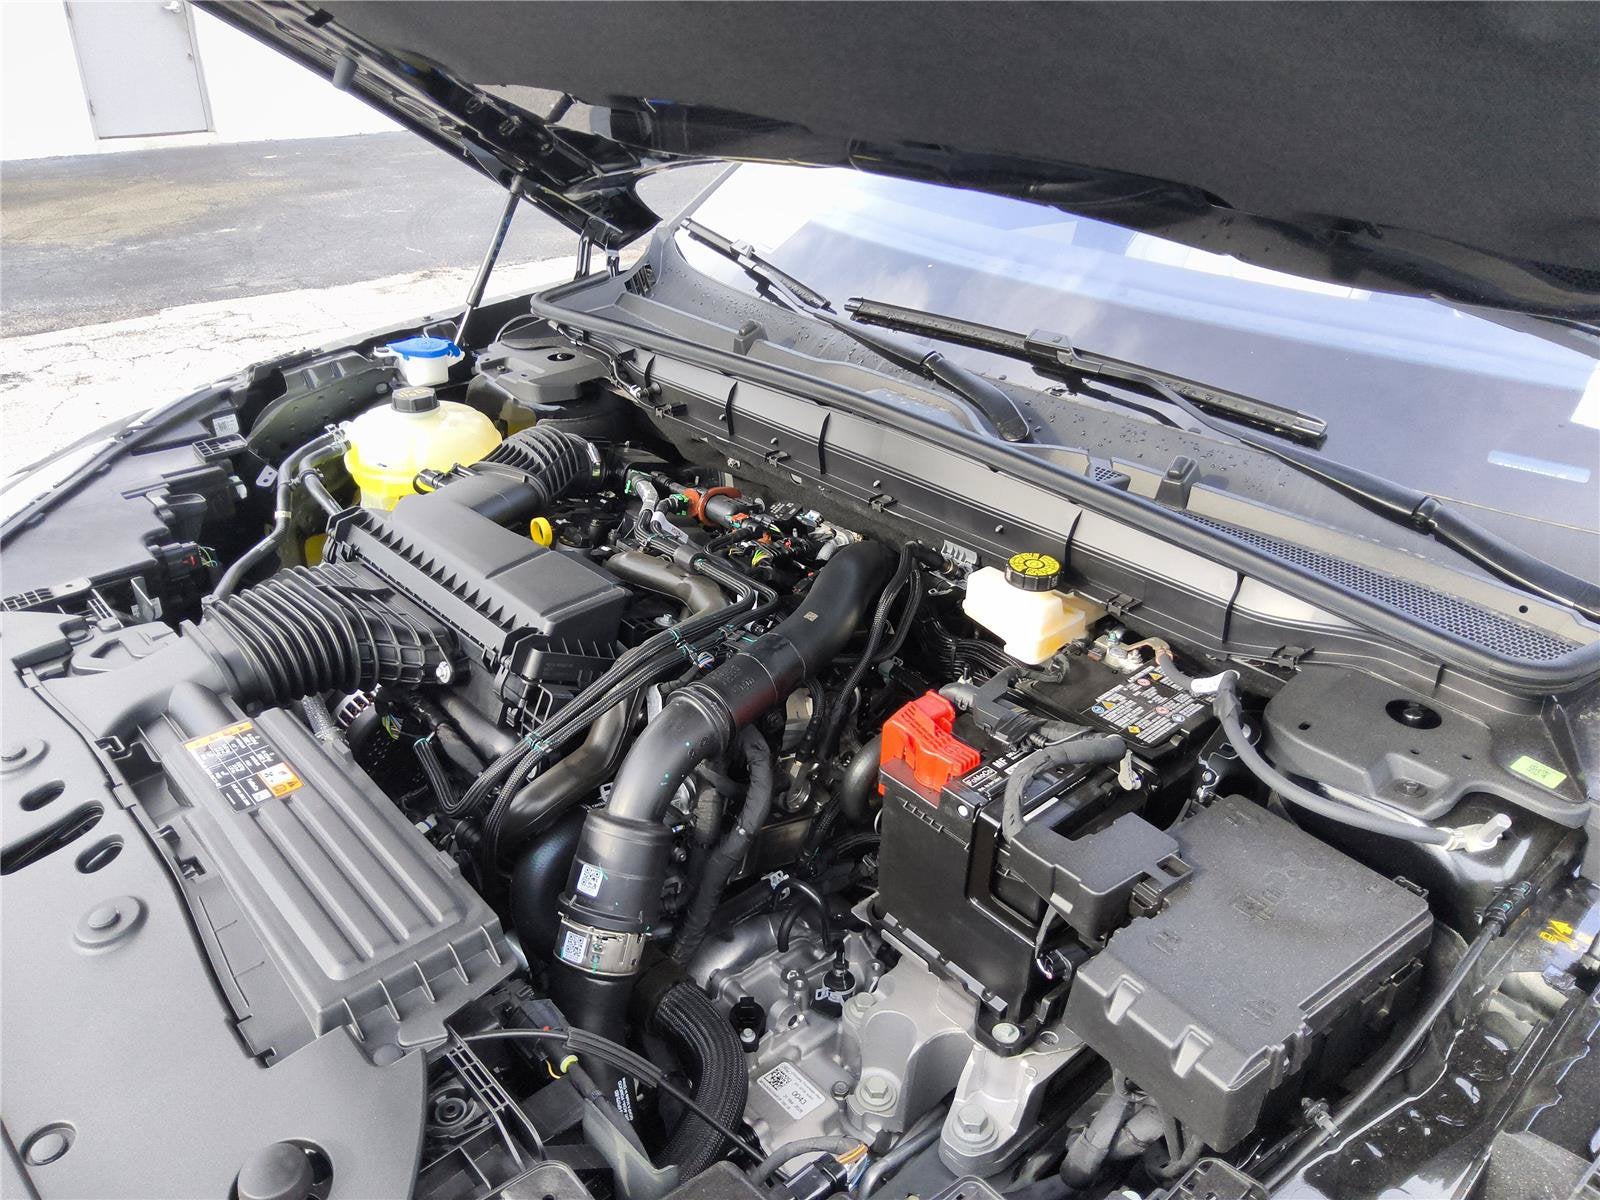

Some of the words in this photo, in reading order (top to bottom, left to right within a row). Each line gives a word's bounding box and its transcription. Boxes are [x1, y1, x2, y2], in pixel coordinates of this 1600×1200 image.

[964, 768, 994, 786] FoMoCo
[992, 757, 1008, 769] MF
[791, 1090, 807, 1105] 0043
